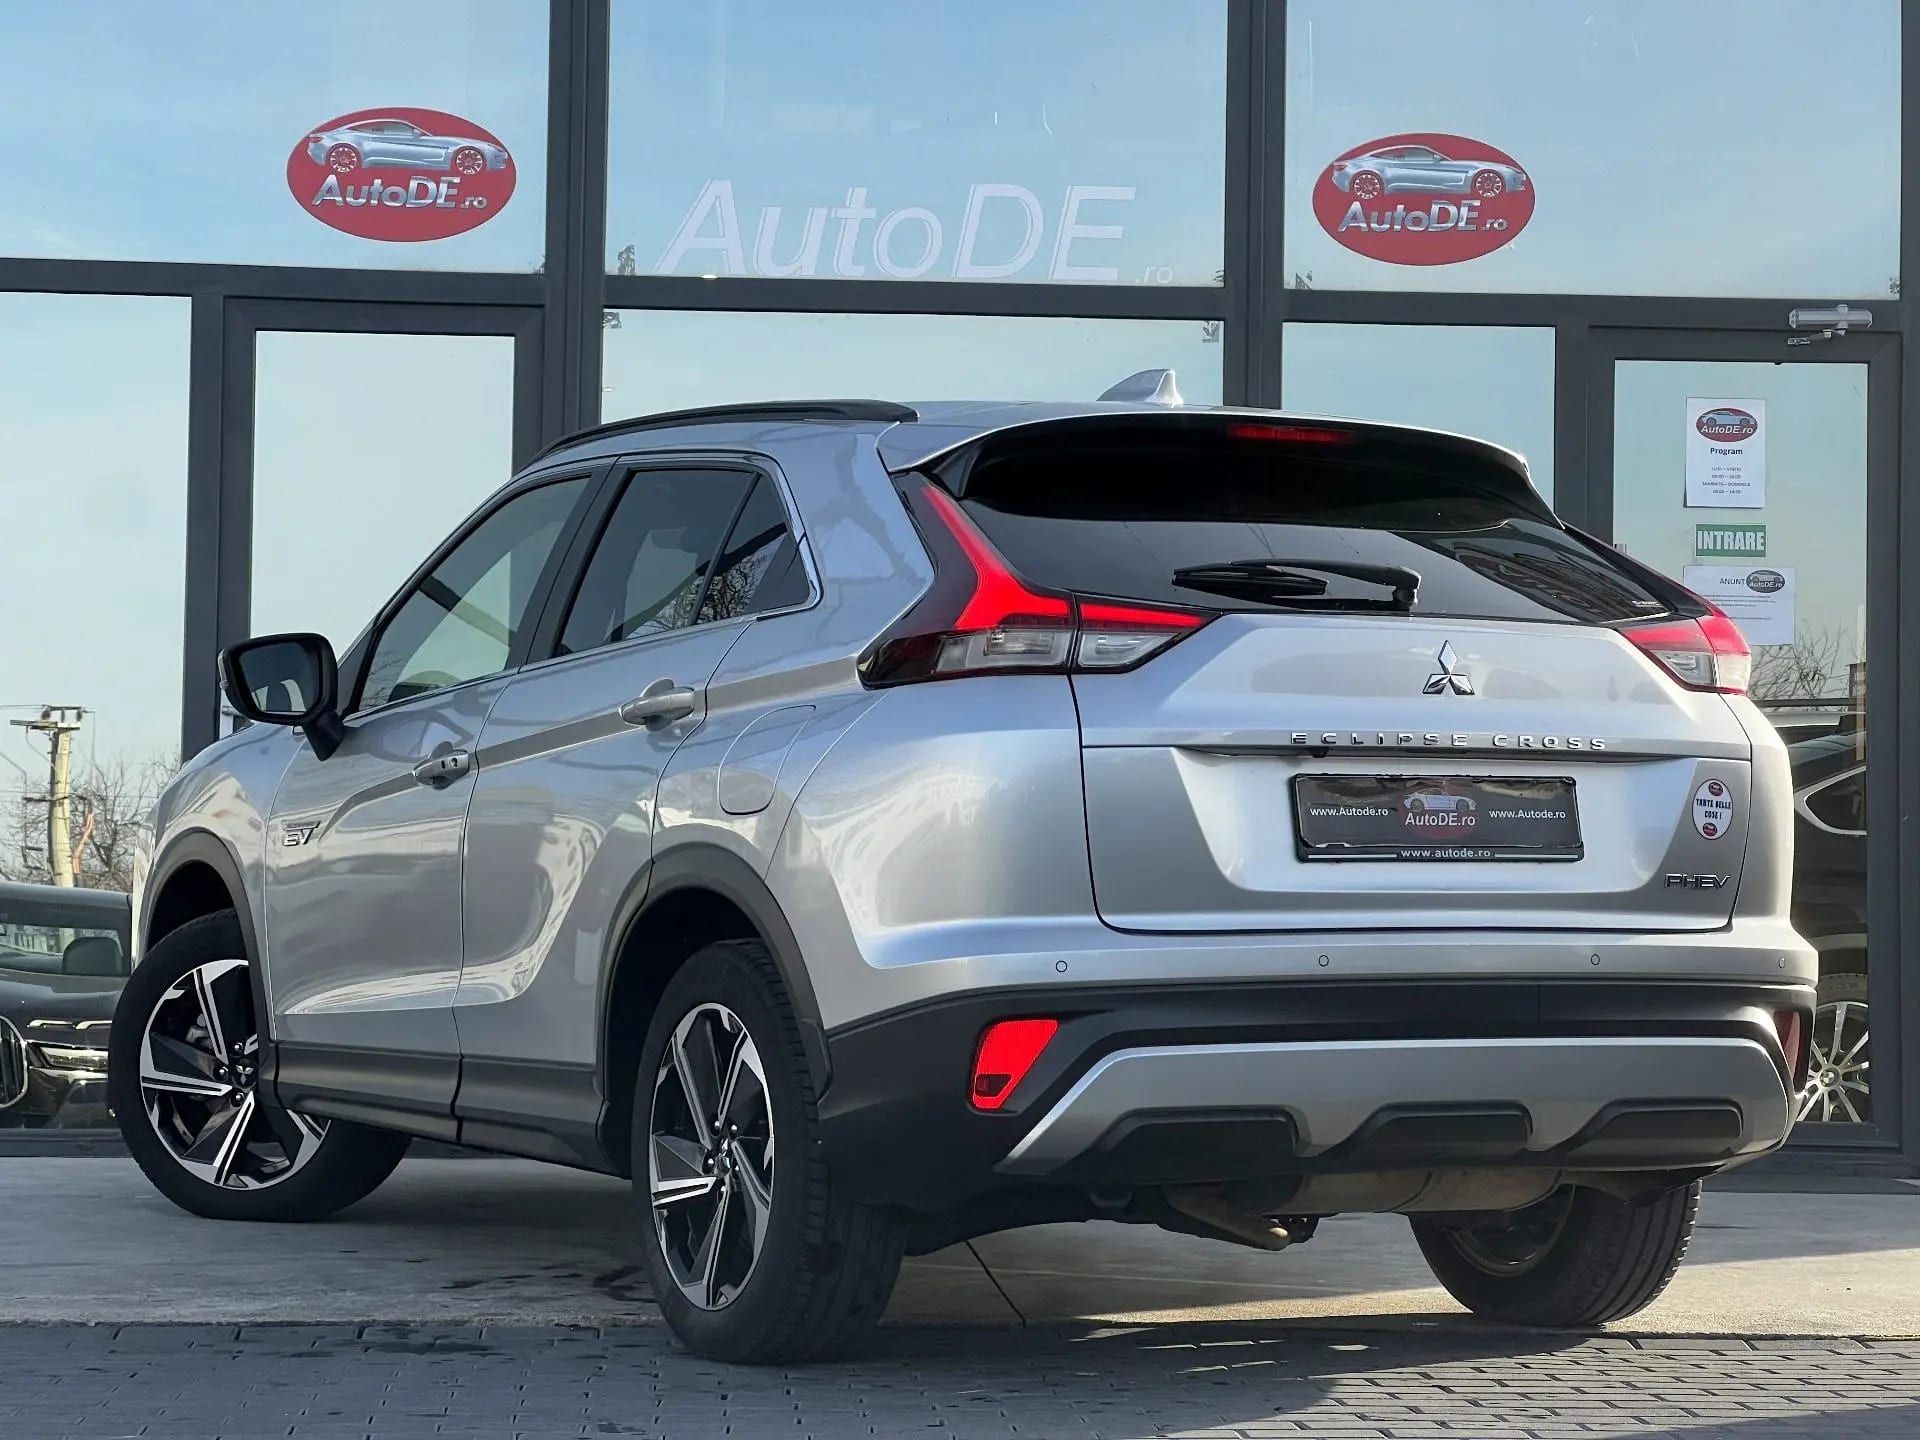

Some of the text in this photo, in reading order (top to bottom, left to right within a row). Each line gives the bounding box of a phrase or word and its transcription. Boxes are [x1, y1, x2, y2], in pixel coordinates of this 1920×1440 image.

[1700, 424, 1754, 434] AutoDE.ro
[1710, 447, 1744, 456] Program
[1697, 530, 1765, 551] INTRARE
[1291, 732, 1607, 751] ECLIPSE CROSS
[1309, 805, 1389, 817] www.Autode.ro
[1488, 808, 1567, 820] www.Autode.ro
[1405, 812, 1476, 827] AutoDE.ro
[1400, 848, 1492, 859] www.autode.ro
[1664, 873, 1732, 889] PHEV
